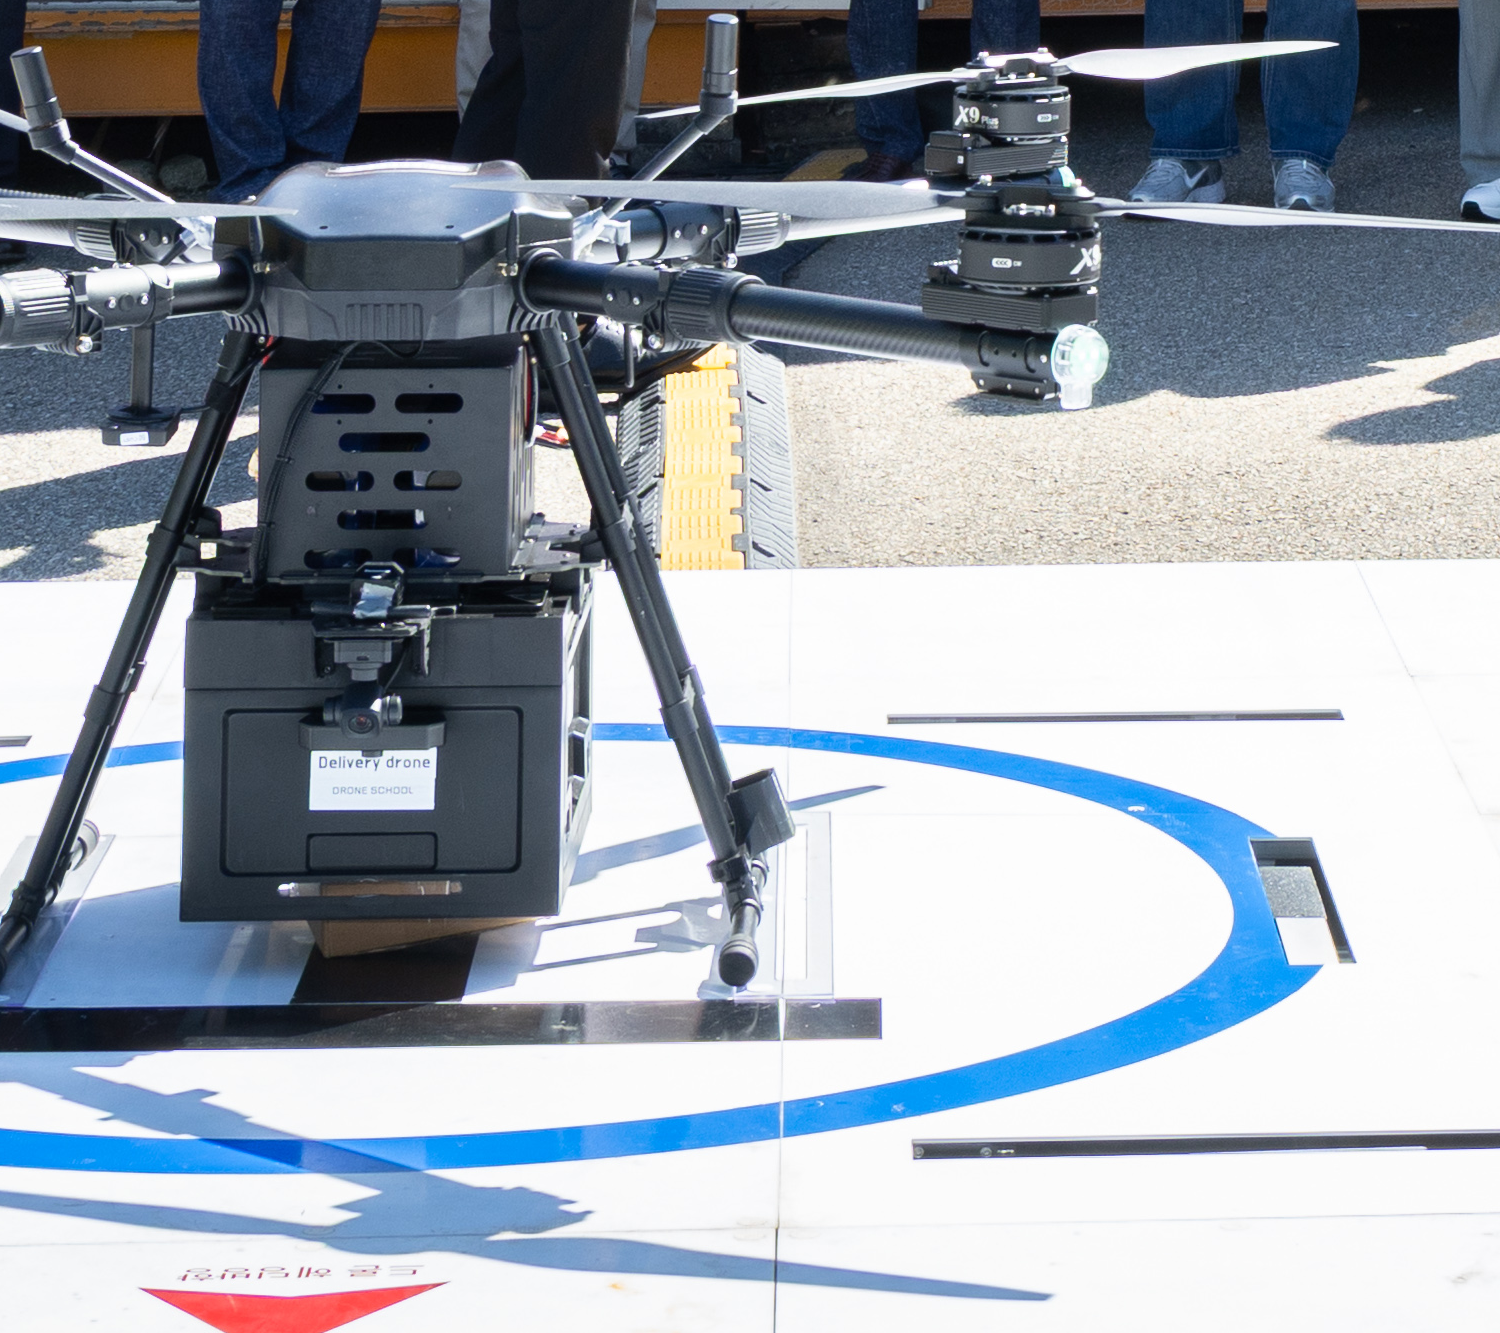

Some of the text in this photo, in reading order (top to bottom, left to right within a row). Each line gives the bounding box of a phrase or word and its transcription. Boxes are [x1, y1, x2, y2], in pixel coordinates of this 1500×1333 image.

[954, 105, 980, 126] X9
[317, 754, 431, 772] Delivery drone
[331, 785, 414, 796] DRONE SCHOOL
